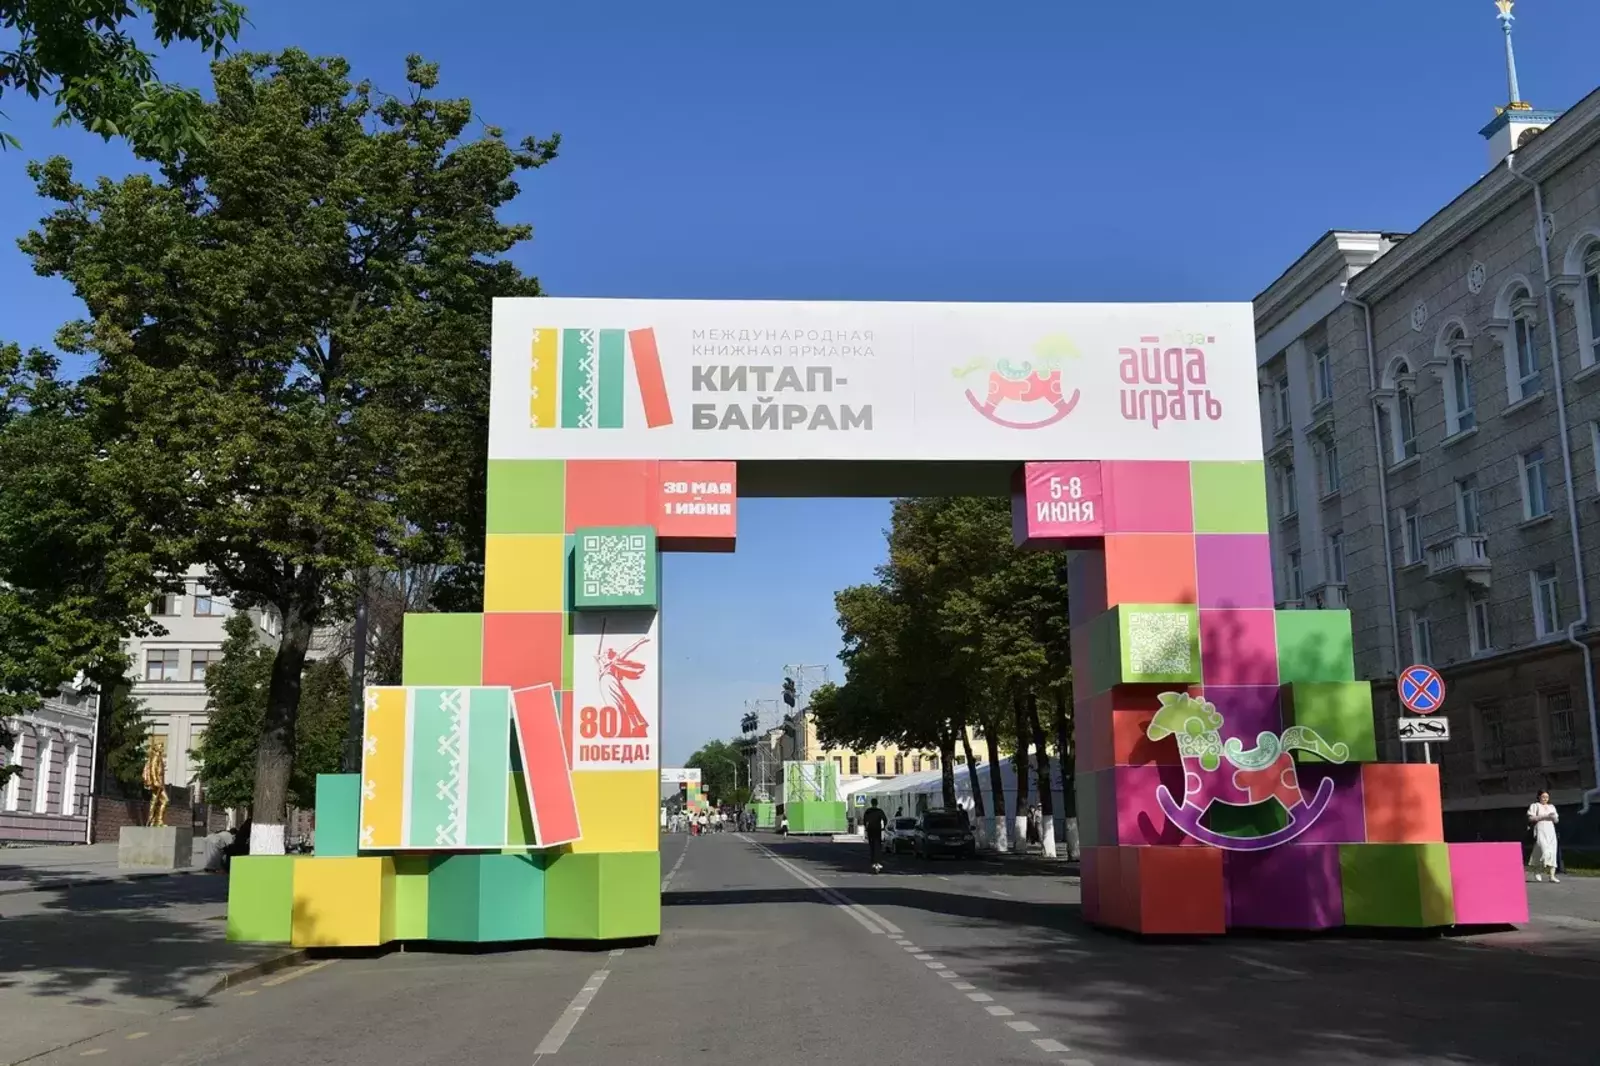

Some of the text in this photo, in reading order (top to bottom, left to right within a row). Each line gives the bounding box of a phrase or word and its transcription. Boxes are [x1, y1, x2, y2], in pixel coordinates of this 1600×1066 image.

[692, 329, 875, 343] МЕЖДУНАРОДНАЯ
[692, 345, 875, 357] КНИЖНАЯ ЯРМАРКА
[692, 365, 848, 392] КИТАП-
[692, 396, 873, 430] БАЙРАМ
[663, 482, 732, 494] 30 МАЯ
[1050, 476, 1082, 499] 5-8
[664, 502, 732, 516] 1 ИЮНЯ
[1036, 501, 1095, 523] ИЮНЯ
[579, 706, 617, 739] 80
[579, 744, 650, 764] ПОБЕДА!
